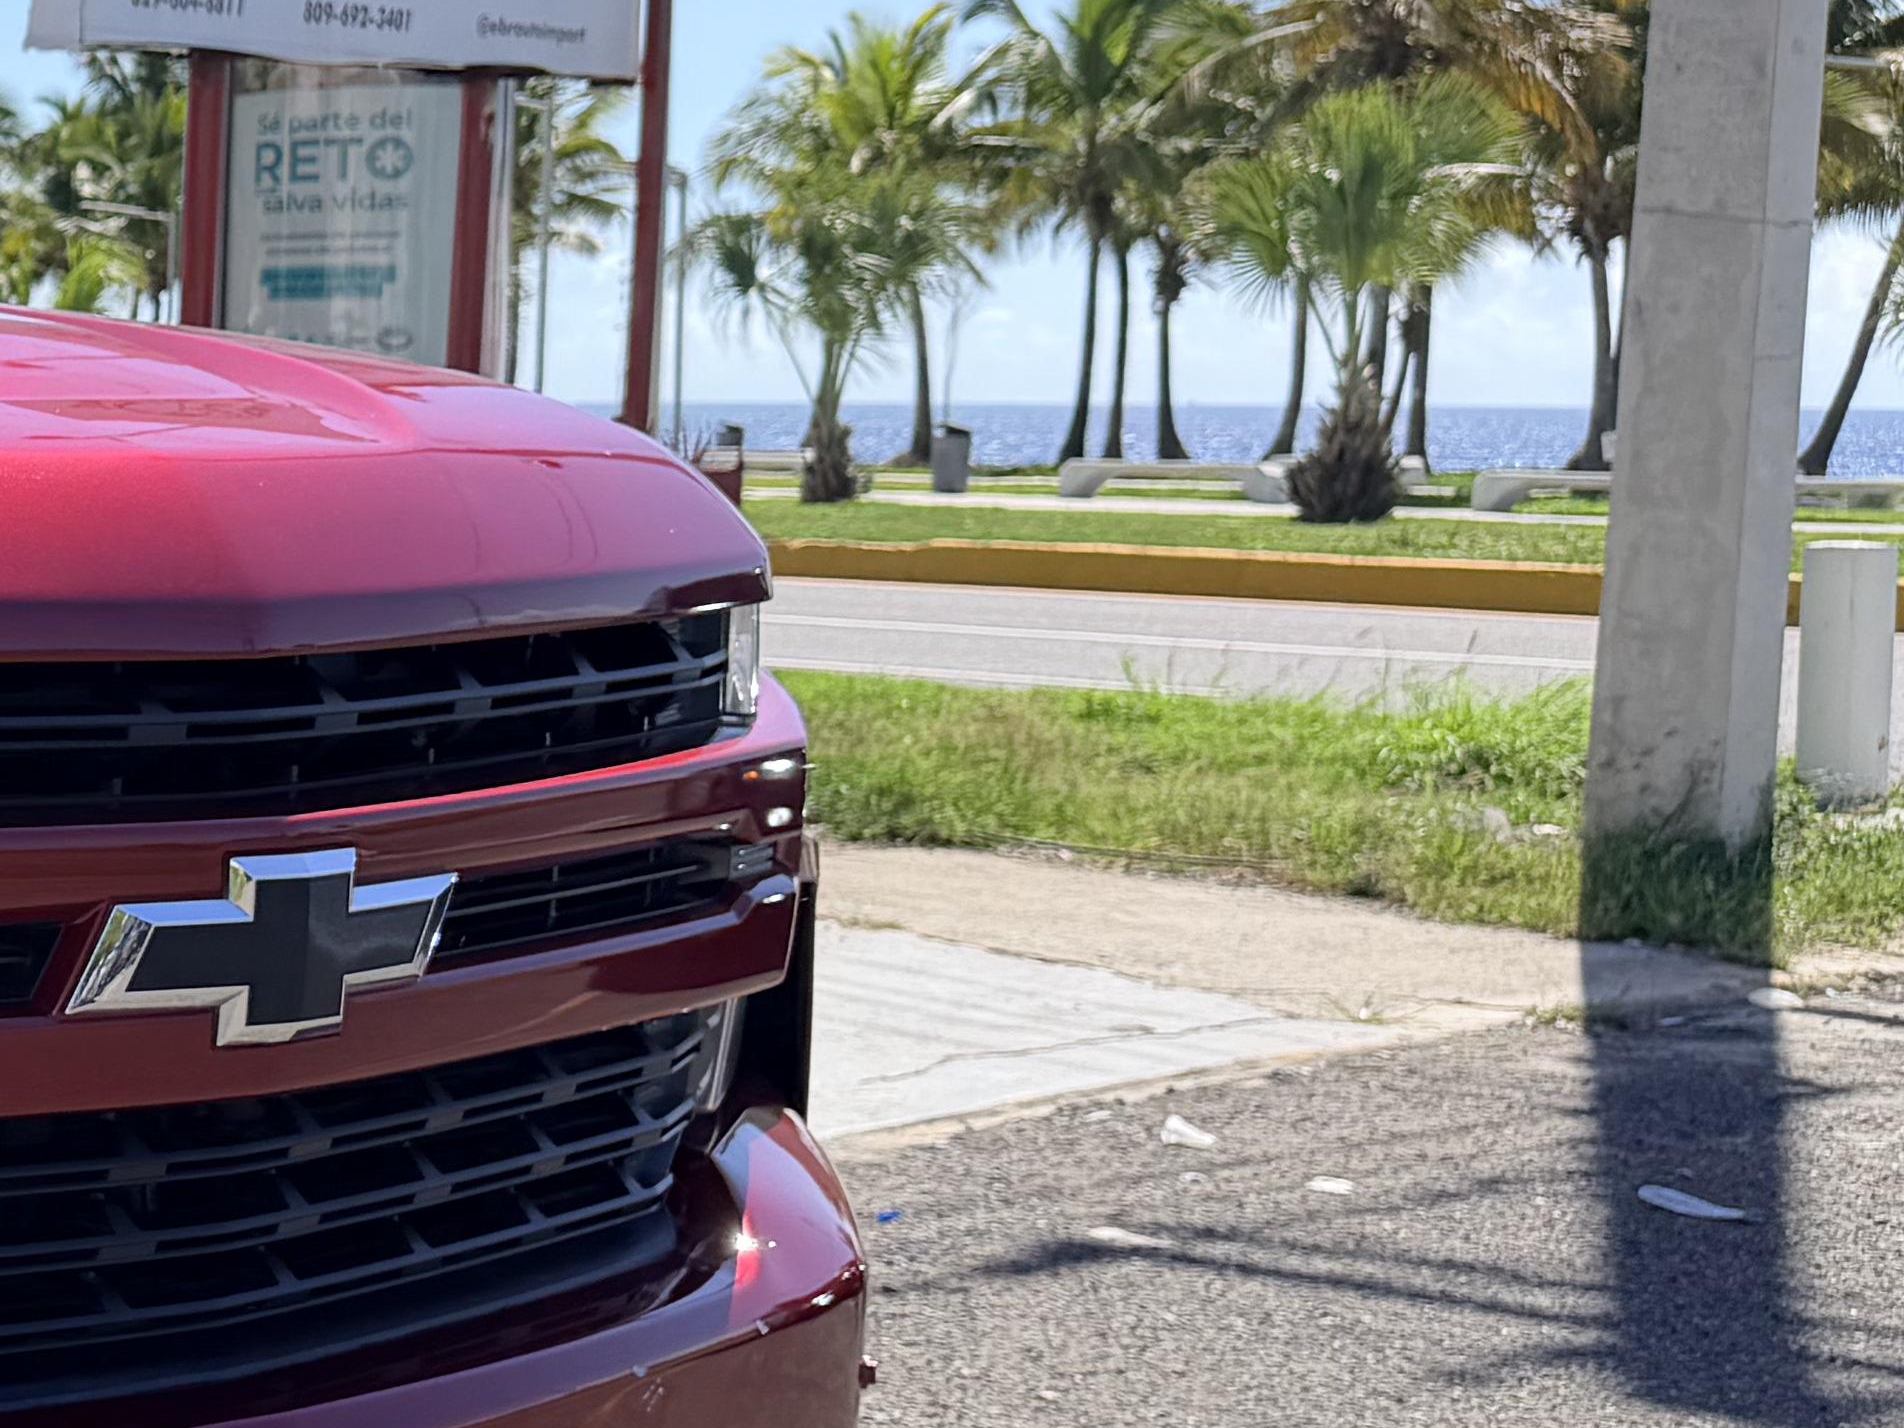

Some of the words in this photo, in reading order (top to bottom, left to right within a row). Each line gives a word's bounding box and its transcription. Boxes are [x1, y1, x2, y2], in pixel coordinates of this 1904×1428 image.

[303, 0, 411, 33] 809-692-3401
[289, 111, 361, 134] parte
[368, 107, 412, 130] del
[255, 136, 414, 186] RETO
[263, 190, 323, 213] salva
[332, 186, 409, 212] vidas
